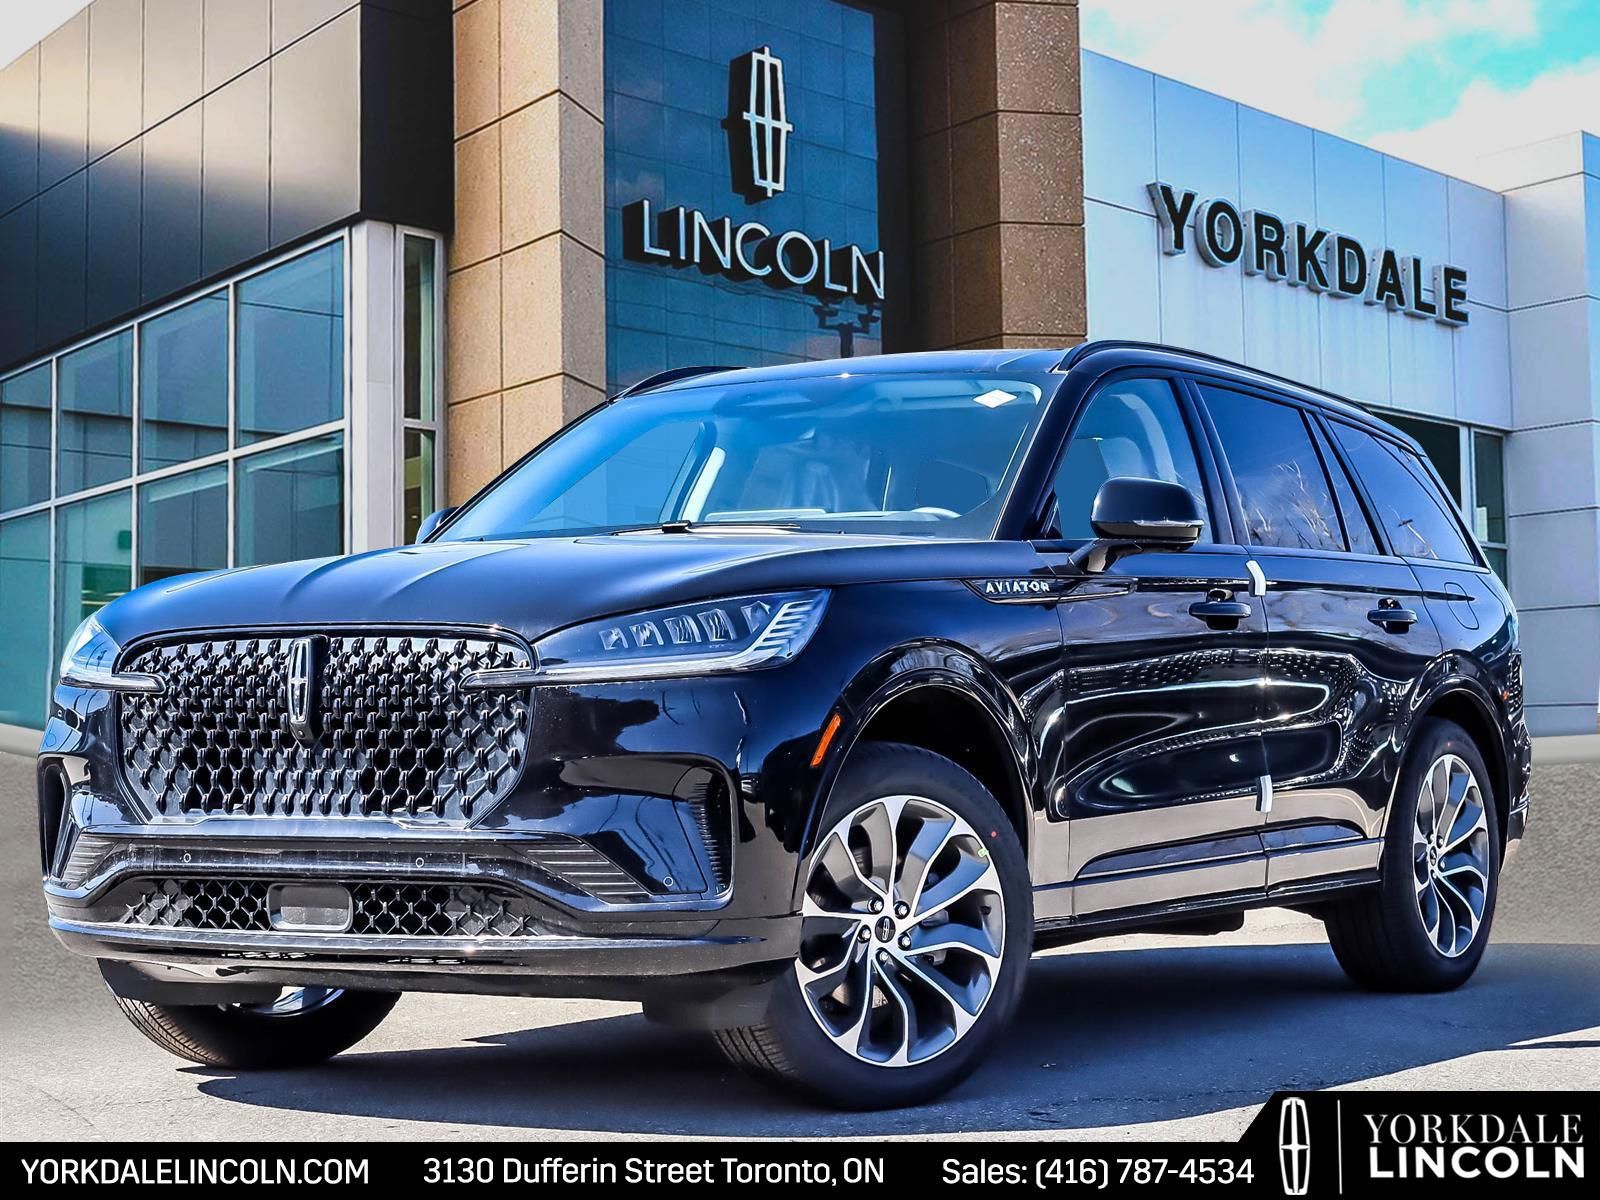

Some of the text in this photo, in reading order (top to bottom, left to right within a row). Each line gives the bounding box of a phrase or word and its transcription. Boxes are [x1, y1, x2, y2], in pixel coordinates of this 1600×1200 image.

[641, 199, 886, 300] LINCOLN
[1150, 182, 1470, 325] YORKDALE
[985, 580, 1051, 594] AVIATOR
